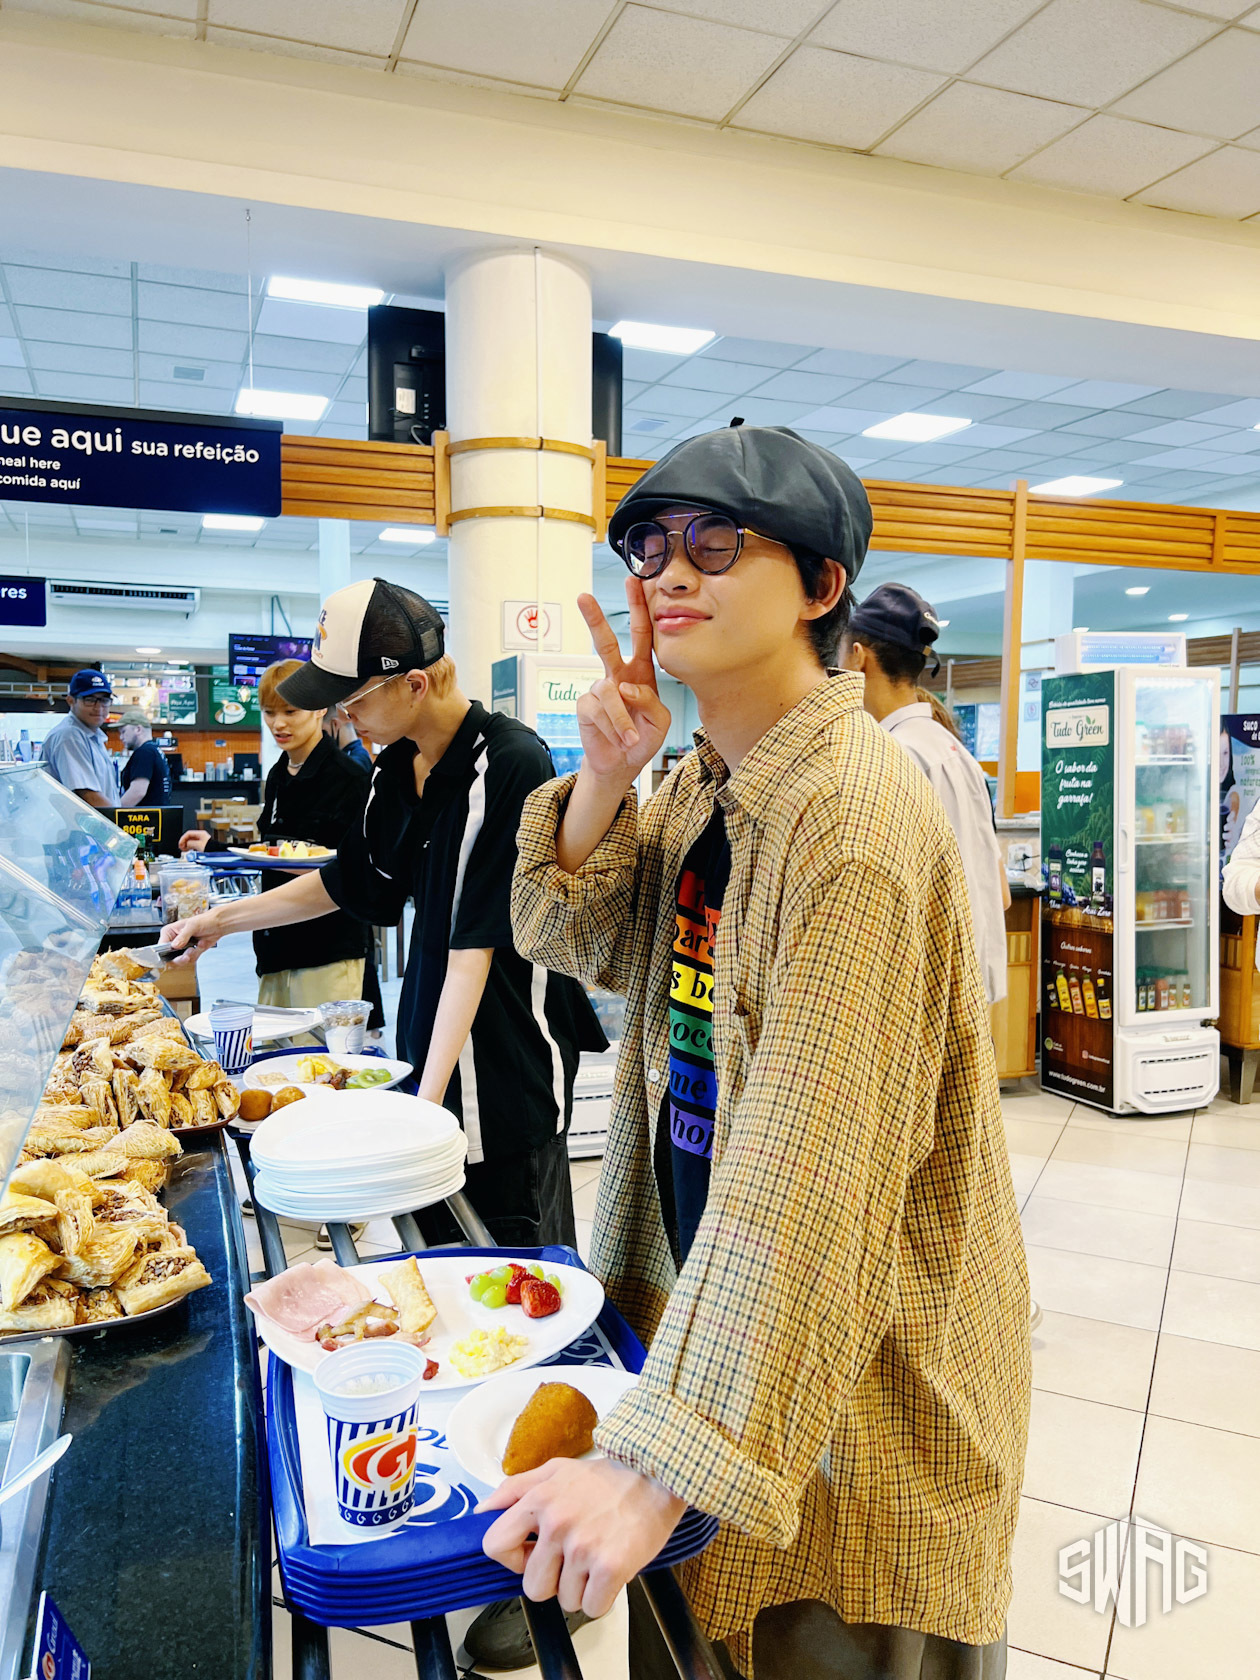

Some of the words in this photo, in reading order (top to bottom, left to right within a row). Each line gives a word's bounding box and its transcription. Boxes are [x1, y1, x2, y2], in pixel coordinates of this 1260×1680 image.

[51, 427, 122, 455] aqui
[131, 440, 169, 456] sua
[173, 441, 260, 464] refeição
[29, 456, 61, 470] here
[50, 478, 81, 490] aquí
[1050, 721, 1072, 738] Tudo
[1076, 719, 1104, 741] Green
[1055, 760, 1064, 774] O
[1064, 761, 1085, 774] sabor
[1085, 761, 1098, 773] da
[1059, 777, 1080, 791] fruta
[1080, 779, 1093, 788] na
[1057, 793, 1093, 809] garrafa!
[127, 814, 150, 822] TARA
